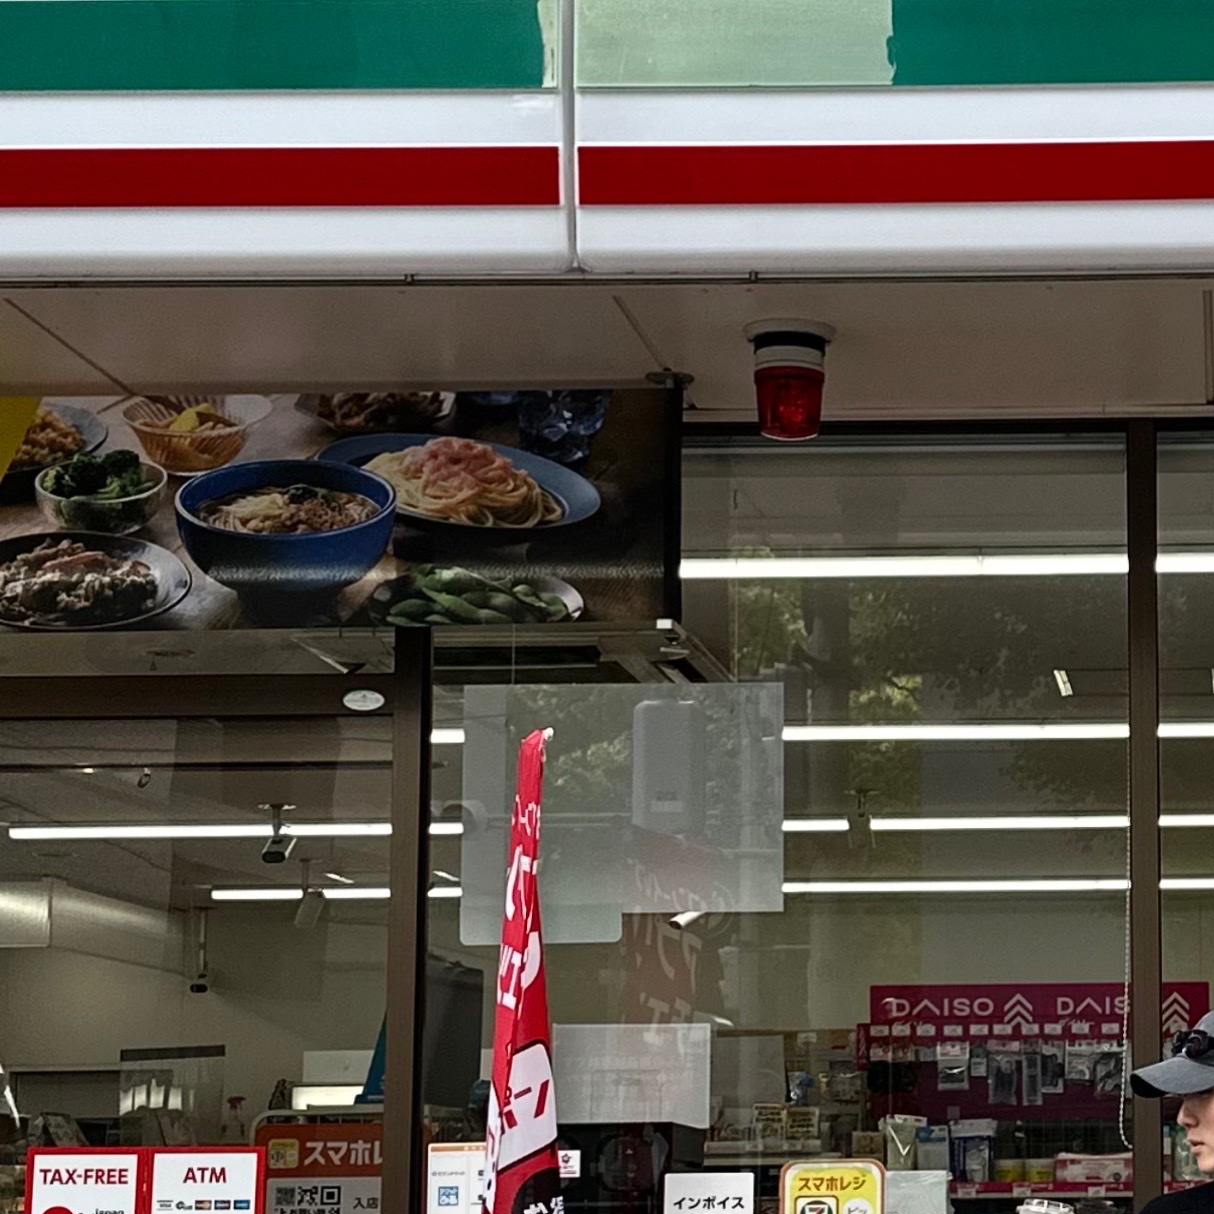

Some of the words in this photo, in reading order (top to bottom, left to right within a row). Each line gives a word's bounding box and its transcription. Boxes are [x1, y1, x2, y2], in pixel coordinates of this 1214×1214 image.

[890, 998, 994, 1016] DAISO
[1056, 997, 1131, 1015] DAIS
[39, 1168, 129, 1185] TAX-FREE
[182, 1167, 227, 1184] ATM
[797, 1174, 867, 1192] スマホレジ
[672, 1195, 745, 1210] インボイス
